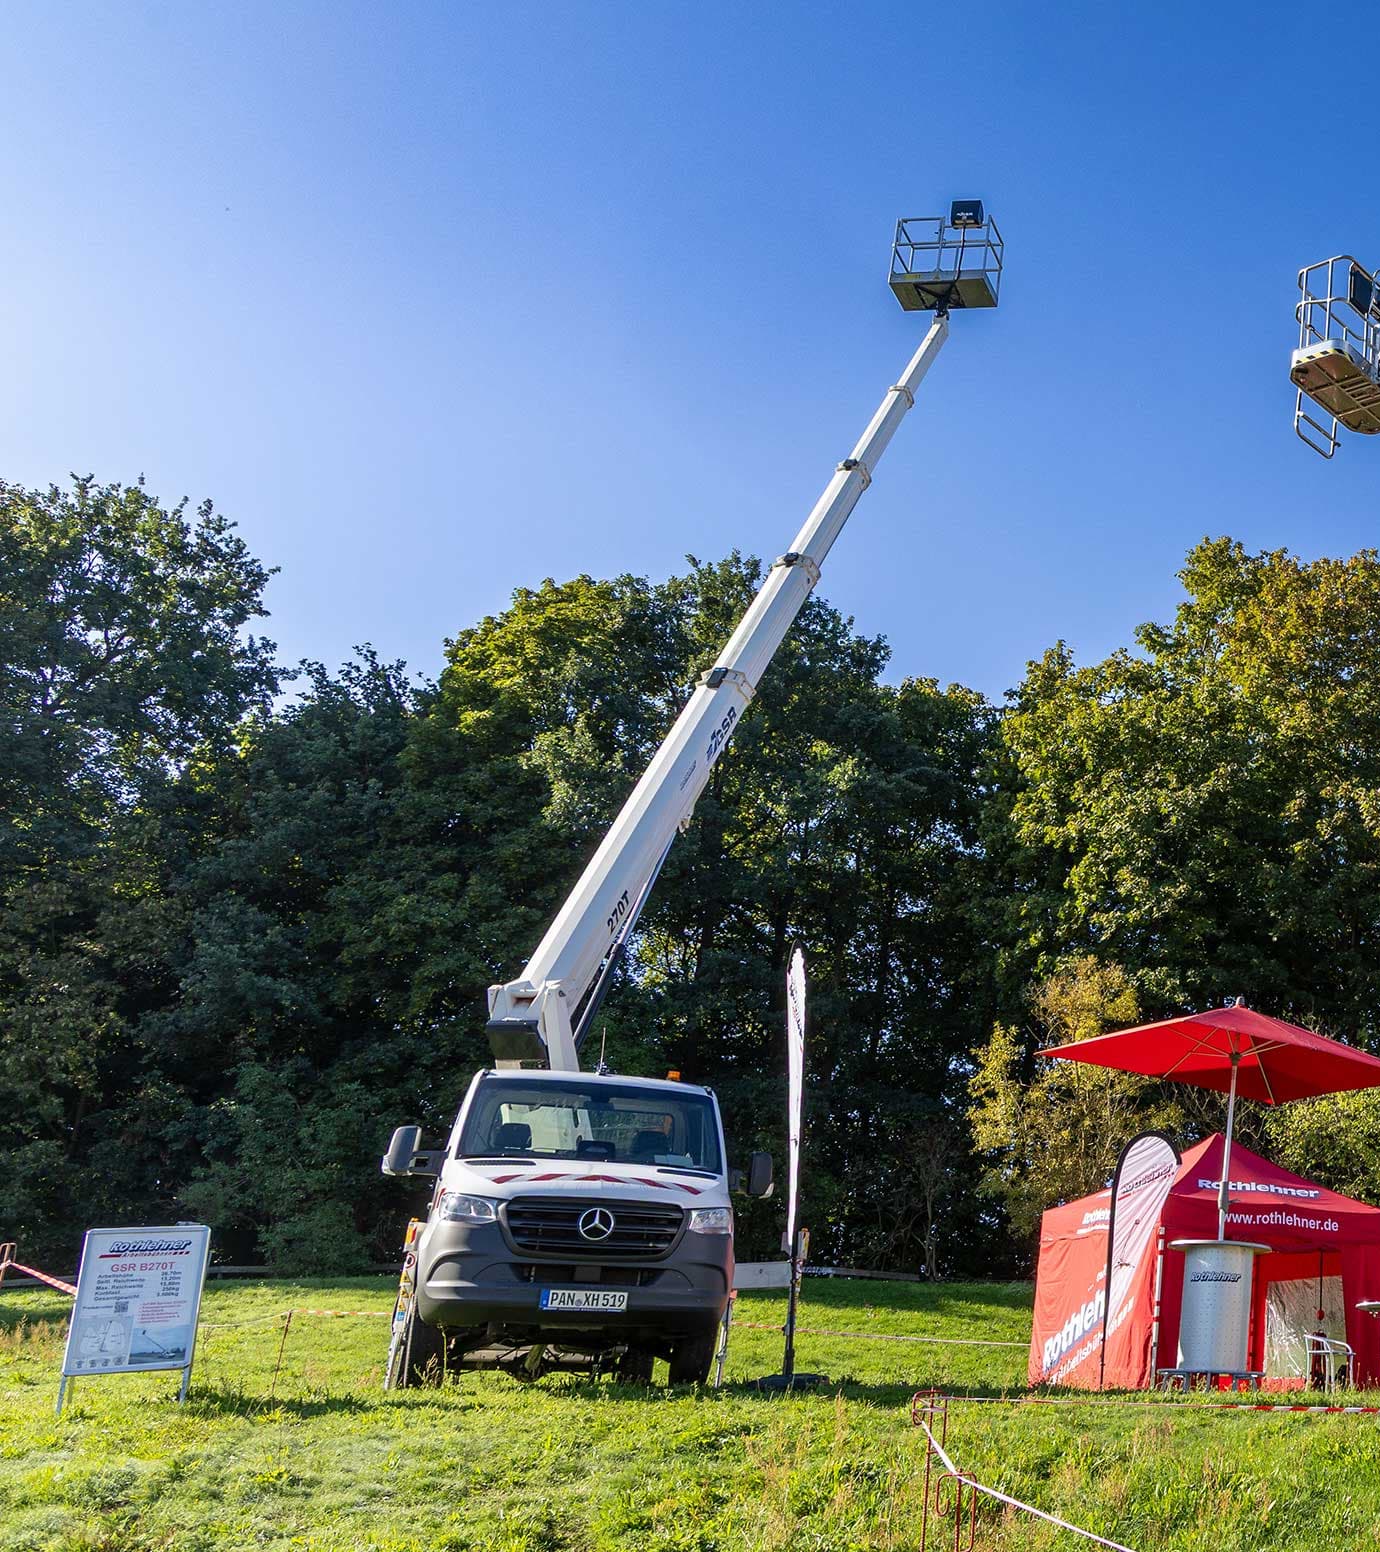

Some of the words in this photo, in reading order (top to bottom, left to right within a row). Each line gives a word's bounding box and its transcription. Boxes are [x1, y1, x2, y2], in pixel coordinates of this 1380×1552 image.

[607, 890, 629, 934] 270T
[1197, 1178, 1320, 1198] Rothlehner
[1224, 1211, 1339, 1231] www.rothlehner.de
[110, 1240, 192, 1253] Rothlehner
[111, 1263, 136, 1272] GSR
[140, 1262, 176, 1271] B270T
[1190, 1271, 1242, 1282] Rothlehner
[550, 1292, 576, 1306] PAN
[583, 1292, 600, 1307] XH
[602, 1293, 625, 1308] 519
